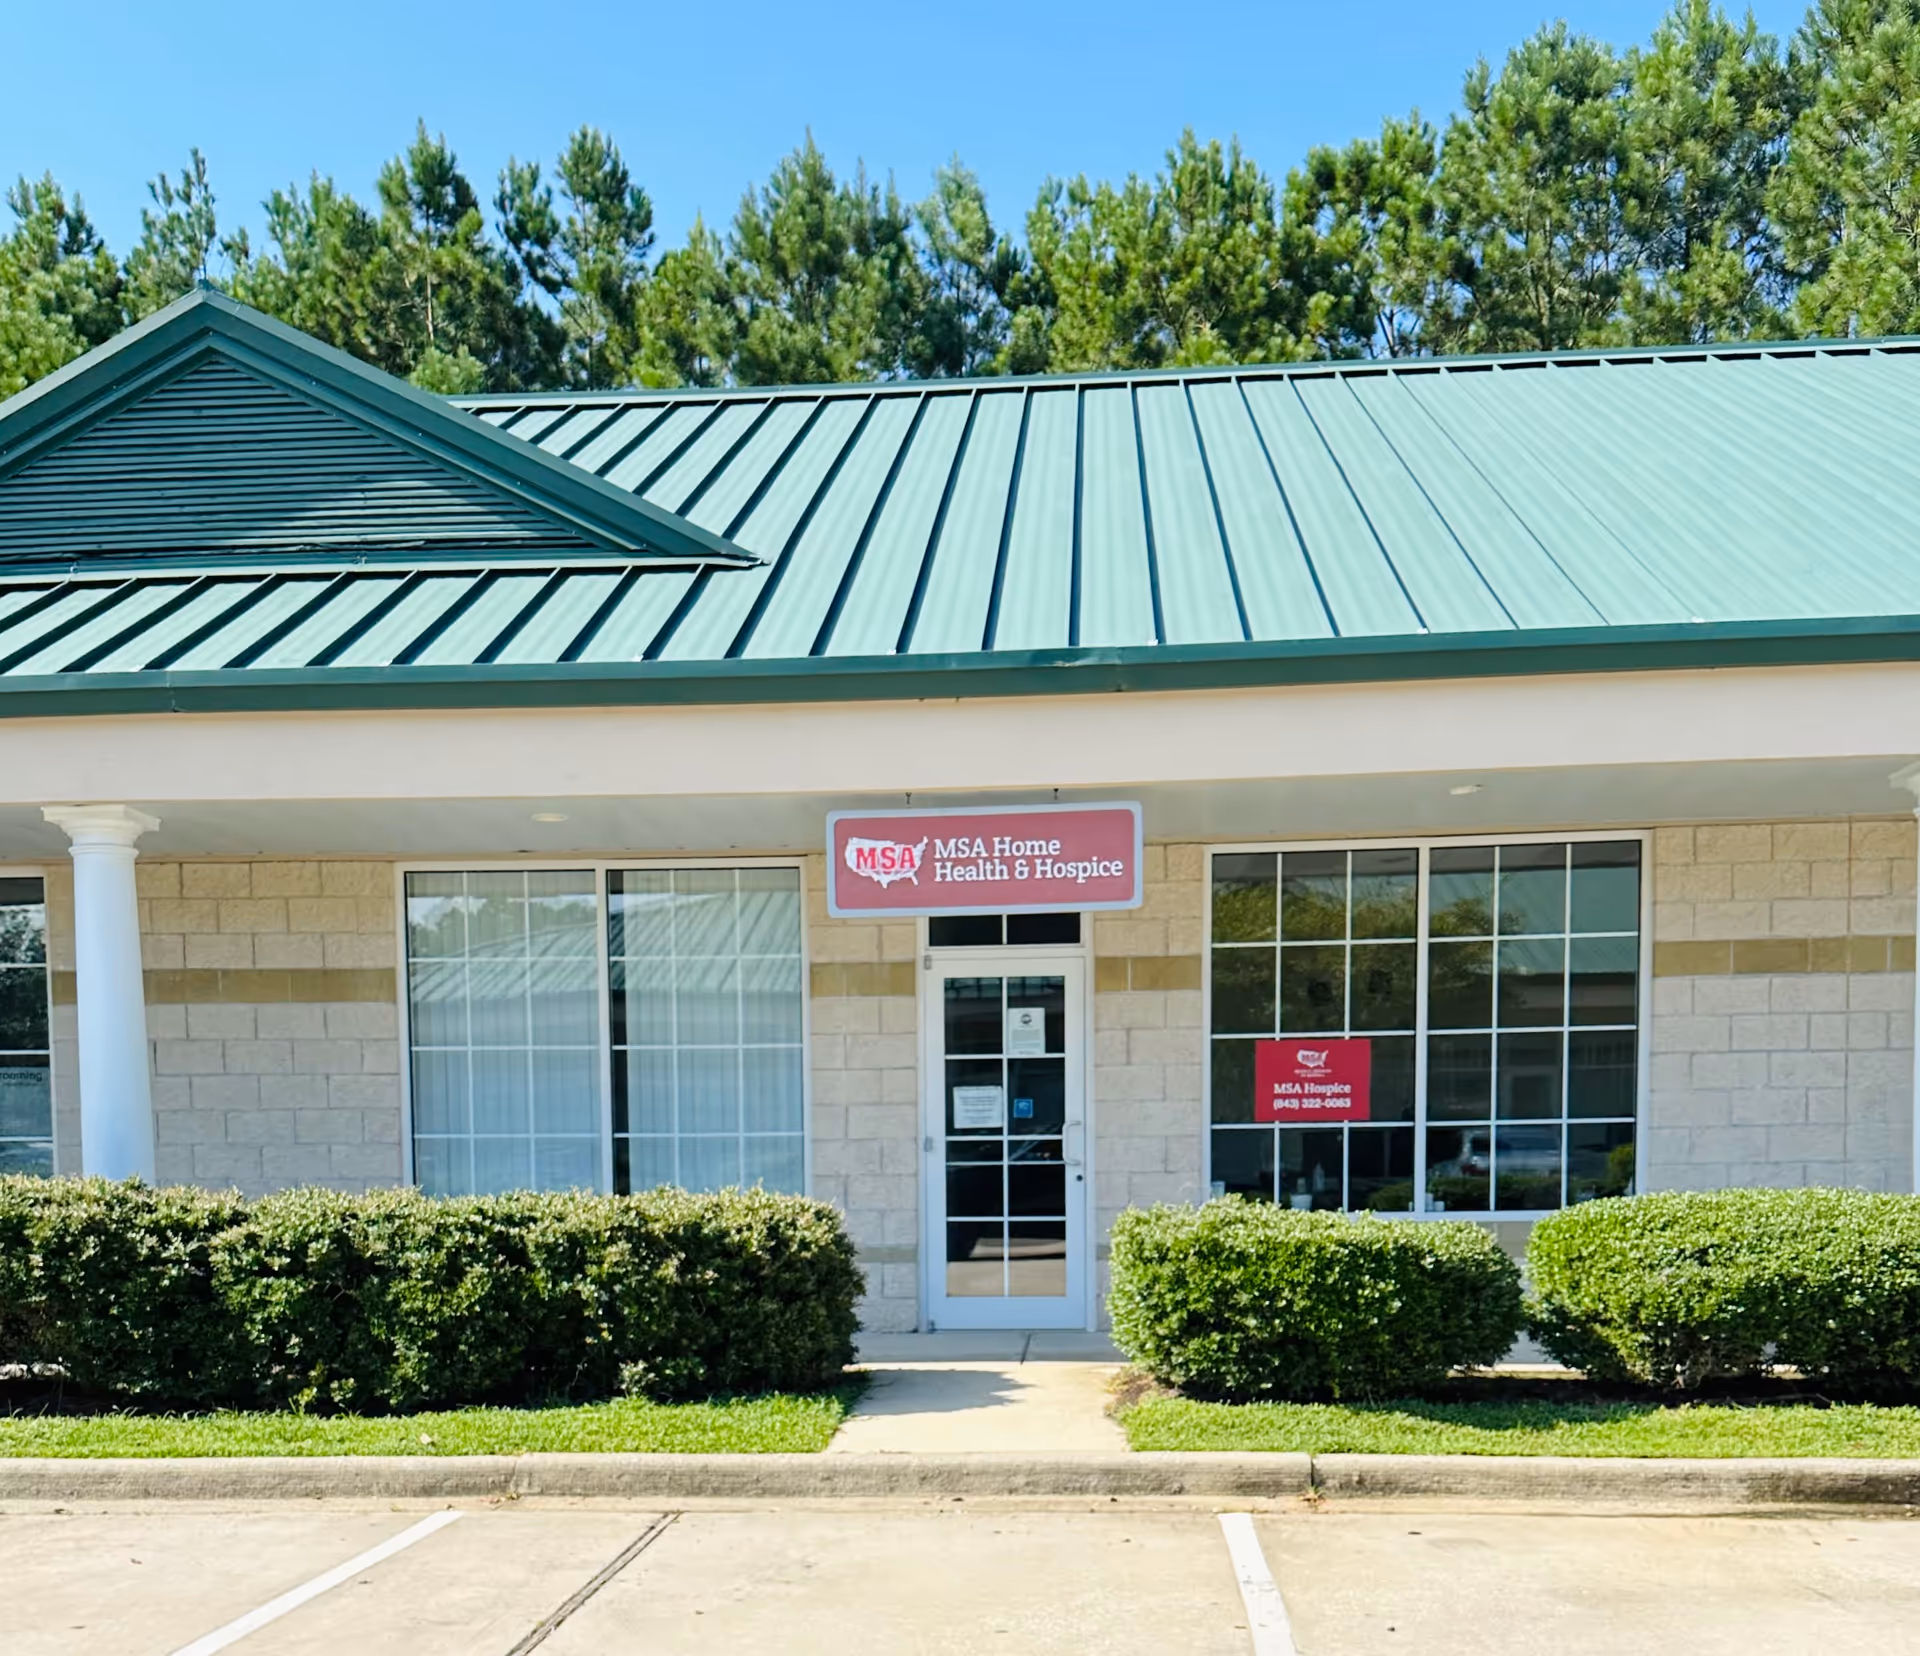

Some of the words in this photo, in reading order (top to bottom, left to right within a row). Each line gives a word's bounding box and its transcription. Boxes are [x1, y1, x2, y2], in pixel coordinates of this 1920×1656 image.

[855, 846, 917, 872] MSA
[933, 838, 988, 859] MSA
[993, 835, 1061, 857] Home
[933, 860, 1010, 882] Health
[1014, 859, 1029, 880] &
[1034, 856, 1124, 884] Hospice
[1273, 1083, 1302, 1094] MSA
[1304, 1082, 1352, 1096] Hospice
